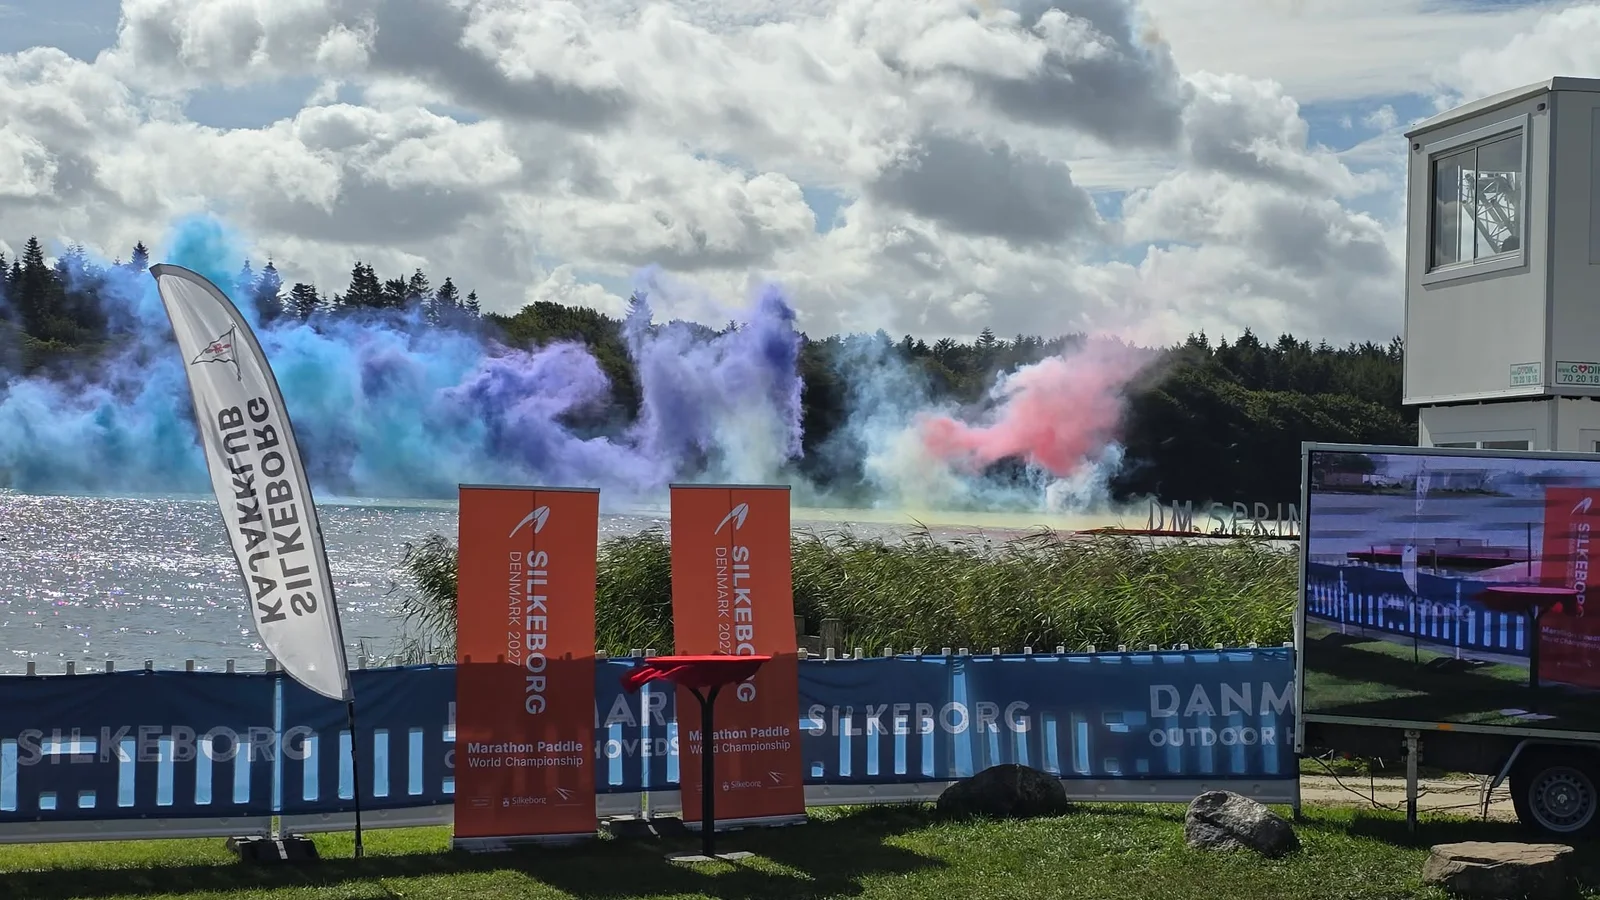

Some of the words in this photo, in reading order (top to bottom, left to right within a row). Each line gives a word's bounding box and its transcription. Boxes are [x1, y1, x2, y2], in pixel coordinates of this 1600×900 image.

[1562, 374, 1573, 382] 70
[1576, 374, 1587, 383] 20
[1589, 375, 1600, 383] 18
[1149, 499, 1193, 533] DM
[508, 551, 522, 626] DENMARK
[715, 547, 730, 618] DENMARK
[525, 550, 549, 715] SILKEBORG
[718, 623, 732, 656] 2027
[732, 545, 757, 703] SILKEBOG
[507, 631, 521, 667] 2027
[688, 728, 747, 742] Mathon
[750, 726, 790, 738] Paddle
[807, 700, 1032, 737] SILKEBORG
[16, 725, 314, 766] SILKEBORG
[467, 742, 533, 754] Marathon
[537, 741, 583, 752] Paddle
[722, 740, 791, 753] Championship
[1149, 726, 1275, 747] OUTDOOR
[468, 757, 501, 768] World
[505, 756, 584, 768] Championship
[511, 796, 547, 805] Silkeborg
